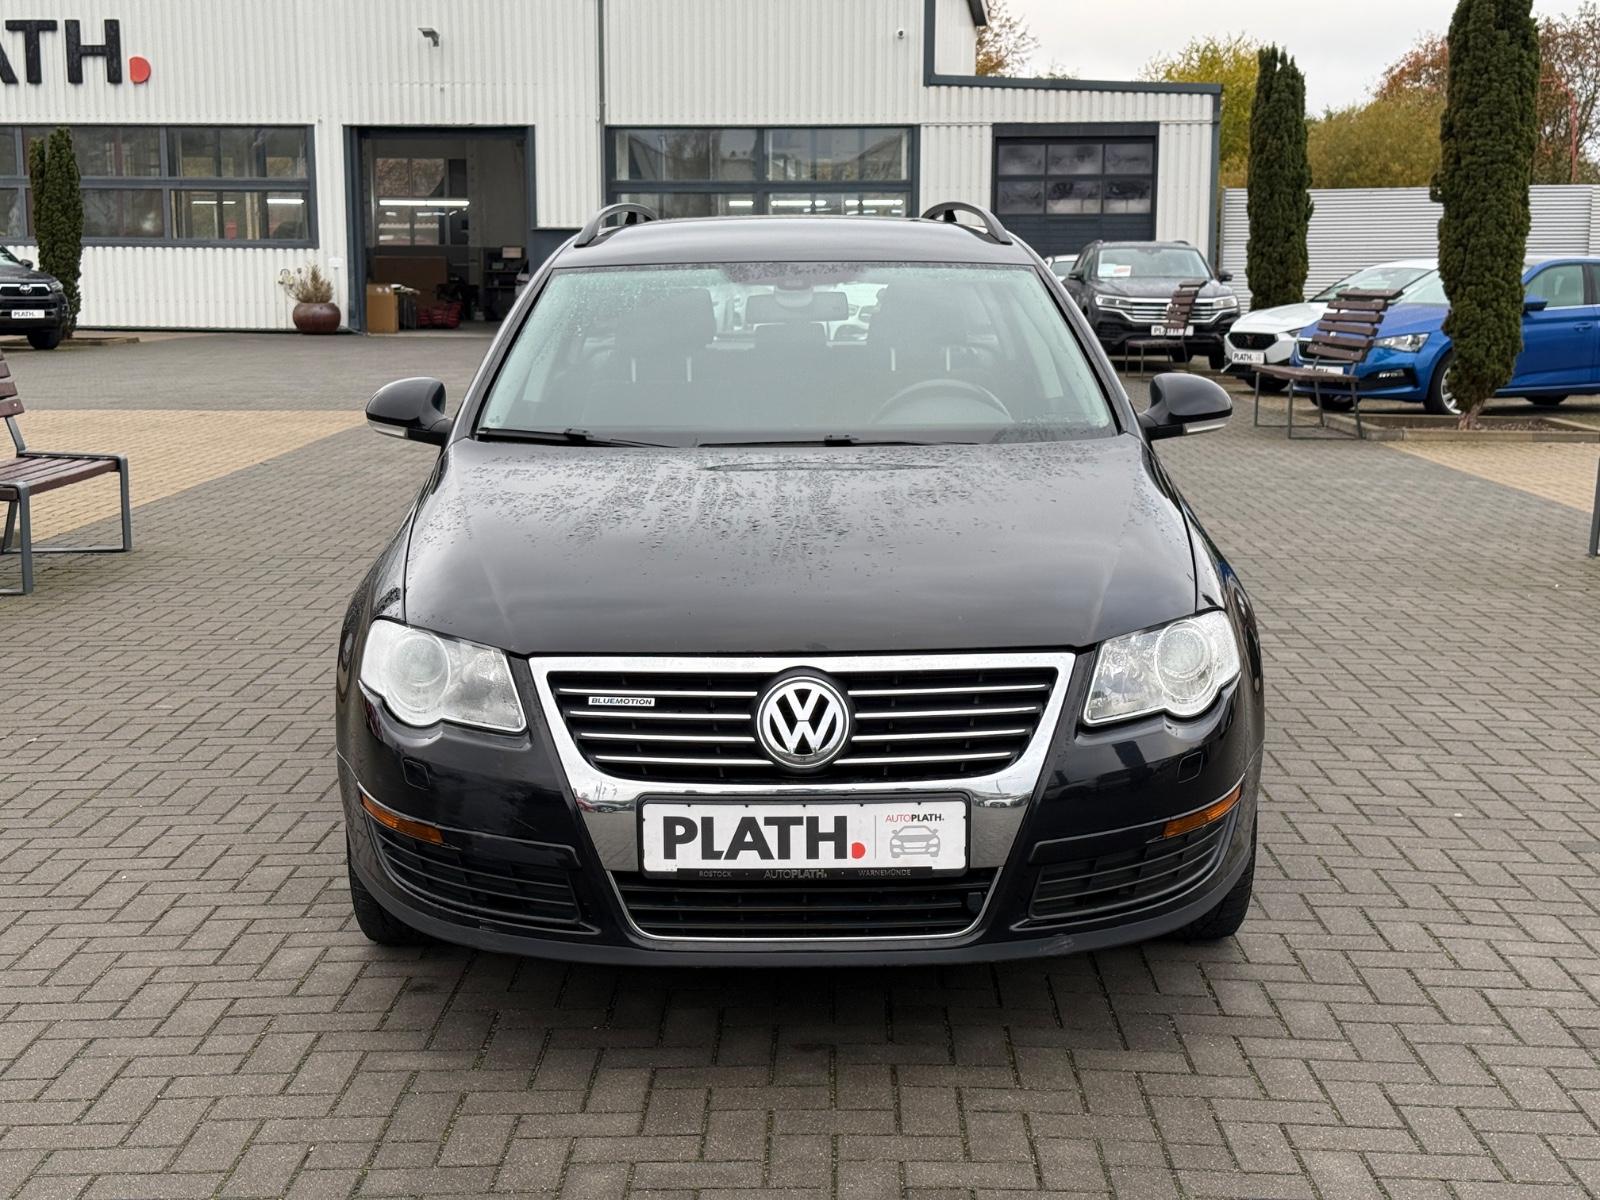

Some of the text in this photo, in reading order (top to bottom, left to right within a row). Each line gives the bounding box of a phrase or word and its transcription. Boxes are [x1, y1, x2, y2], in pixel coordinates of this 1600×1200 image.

[591, 697, 652, 705] BLUEMOTION
[662, 815, 866, 861] PLATH.
[699, 870, 732, 878] ROSTOCK
